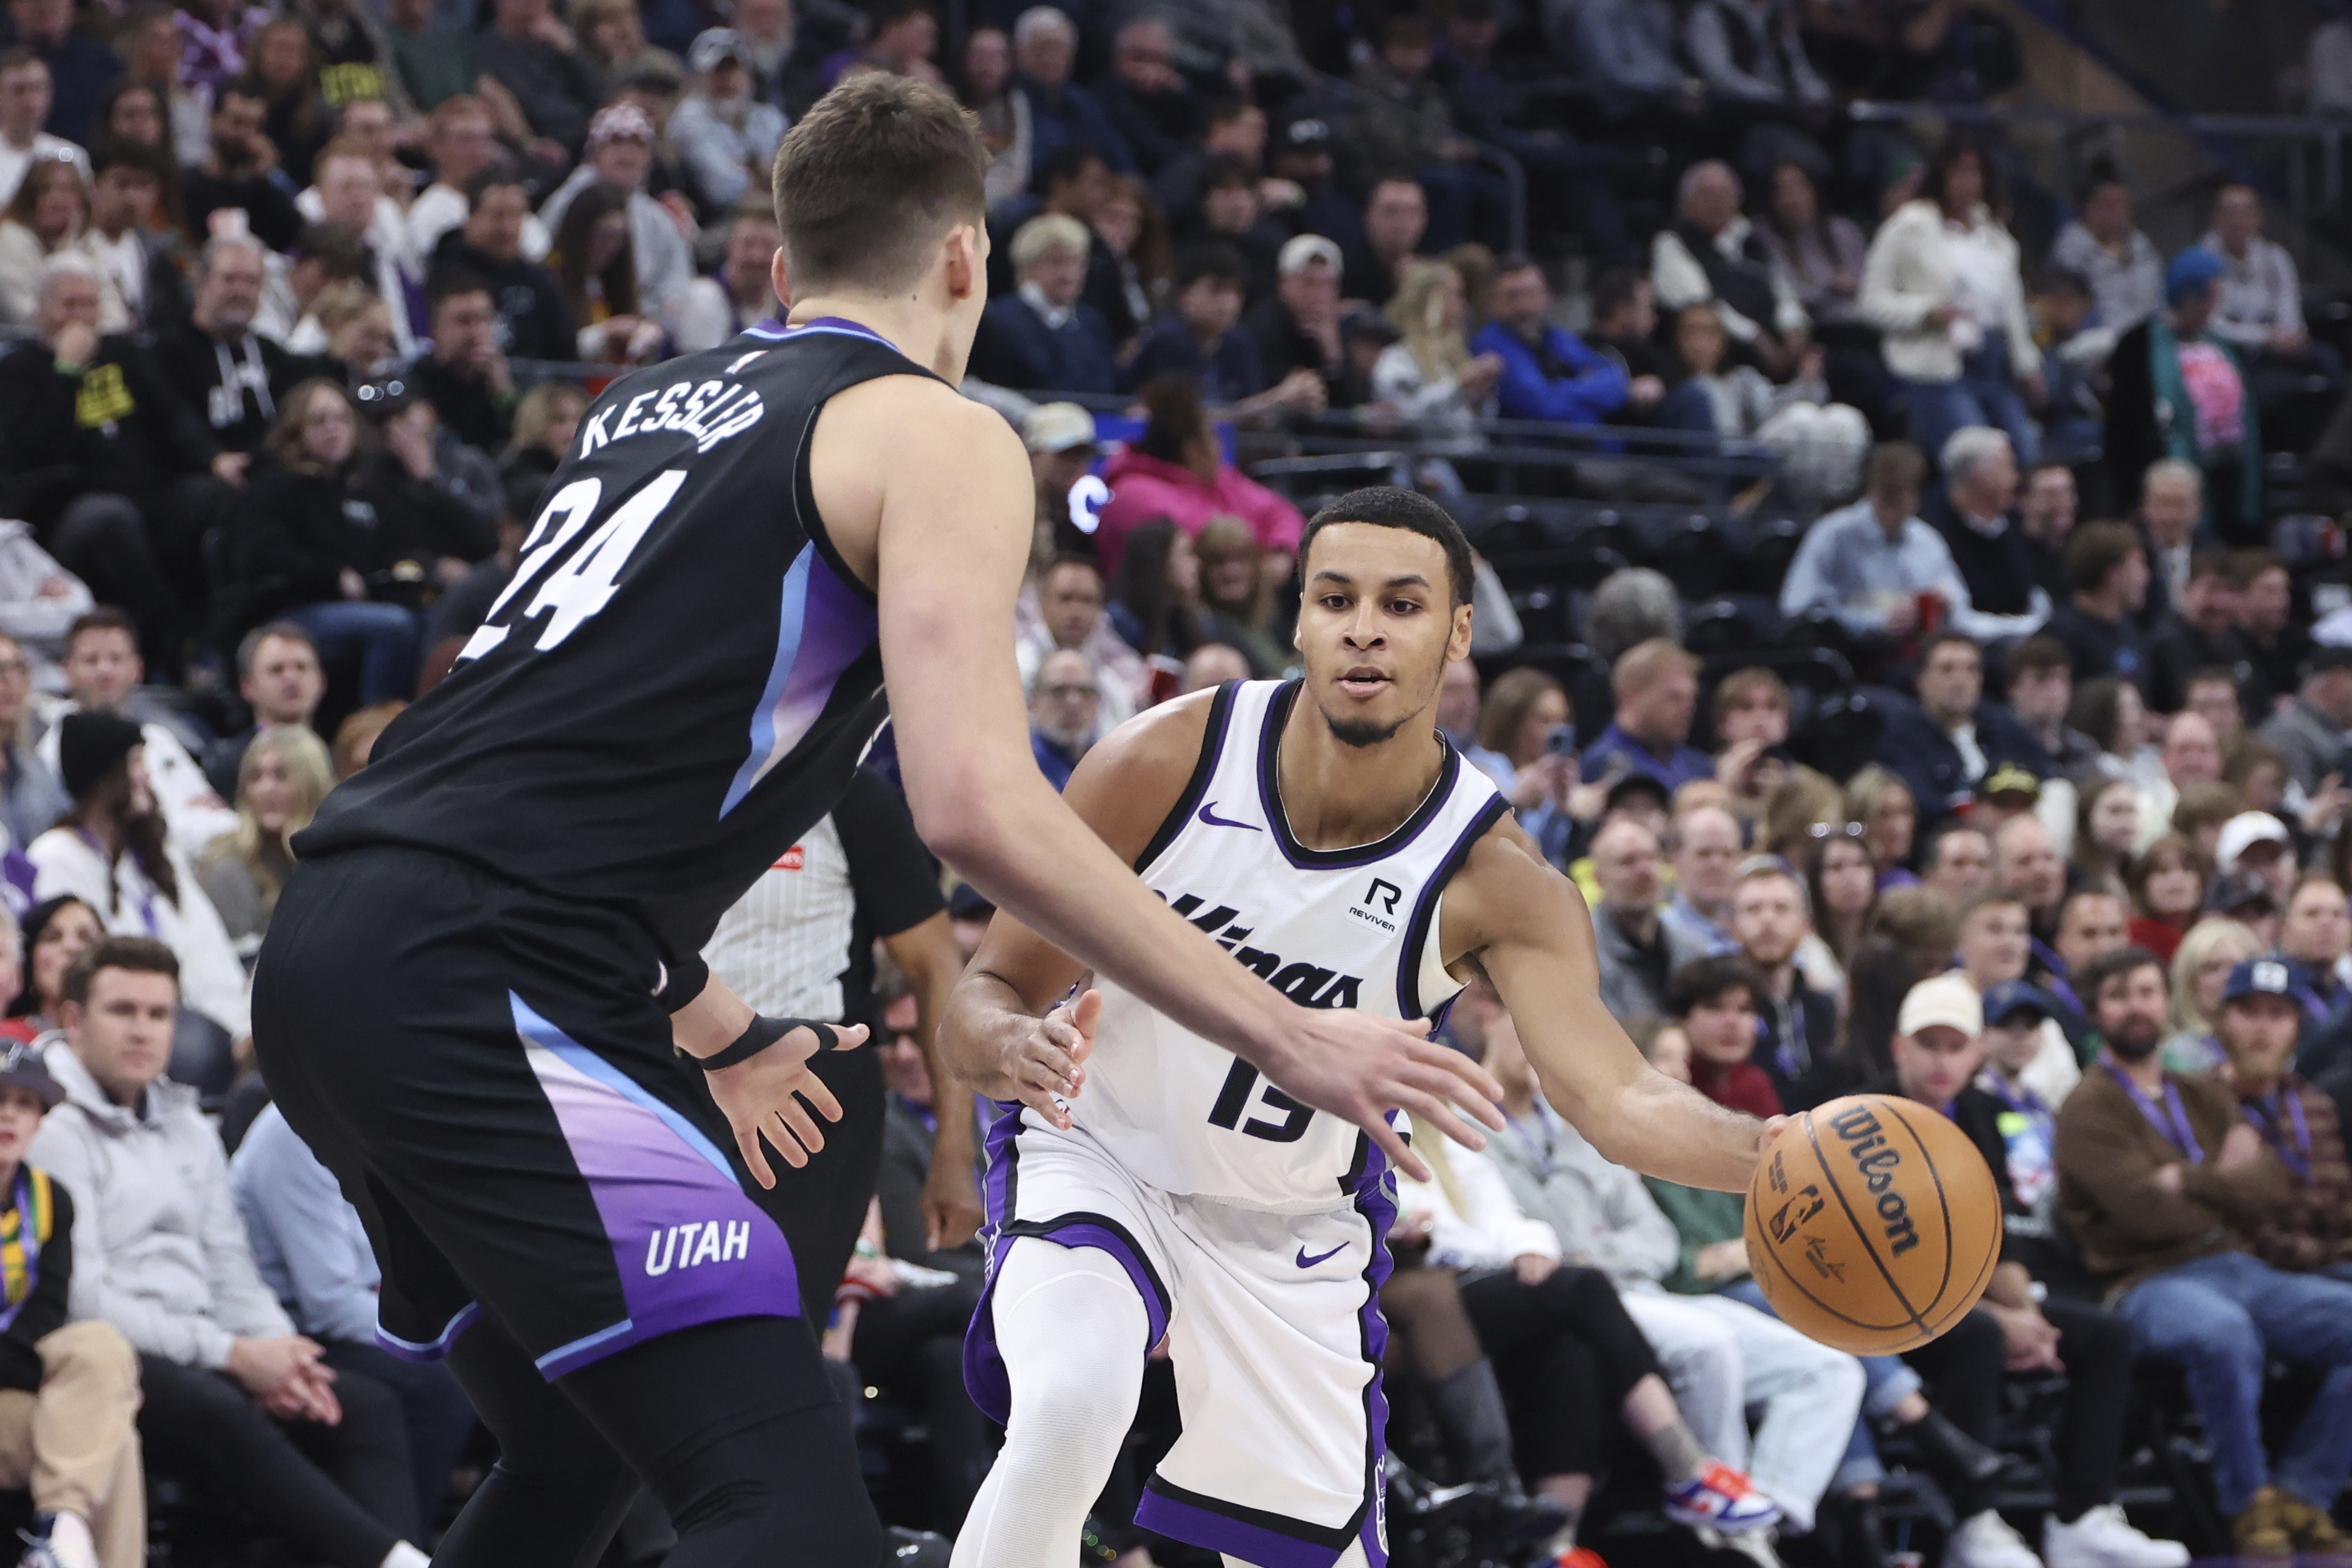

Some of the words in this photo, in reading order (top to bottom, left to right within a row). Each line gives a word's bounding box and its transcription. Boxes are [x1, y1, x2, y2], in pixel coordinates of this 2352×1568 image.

[579, 380, 764, 460] KESSLER
[448, 470, 687, 674] 24
[1349, 906, 1396, 933] REVIVER
[1829, 1104, 1921, 1260] Wilson
[645, 1219, 751, 1277] UTAH
